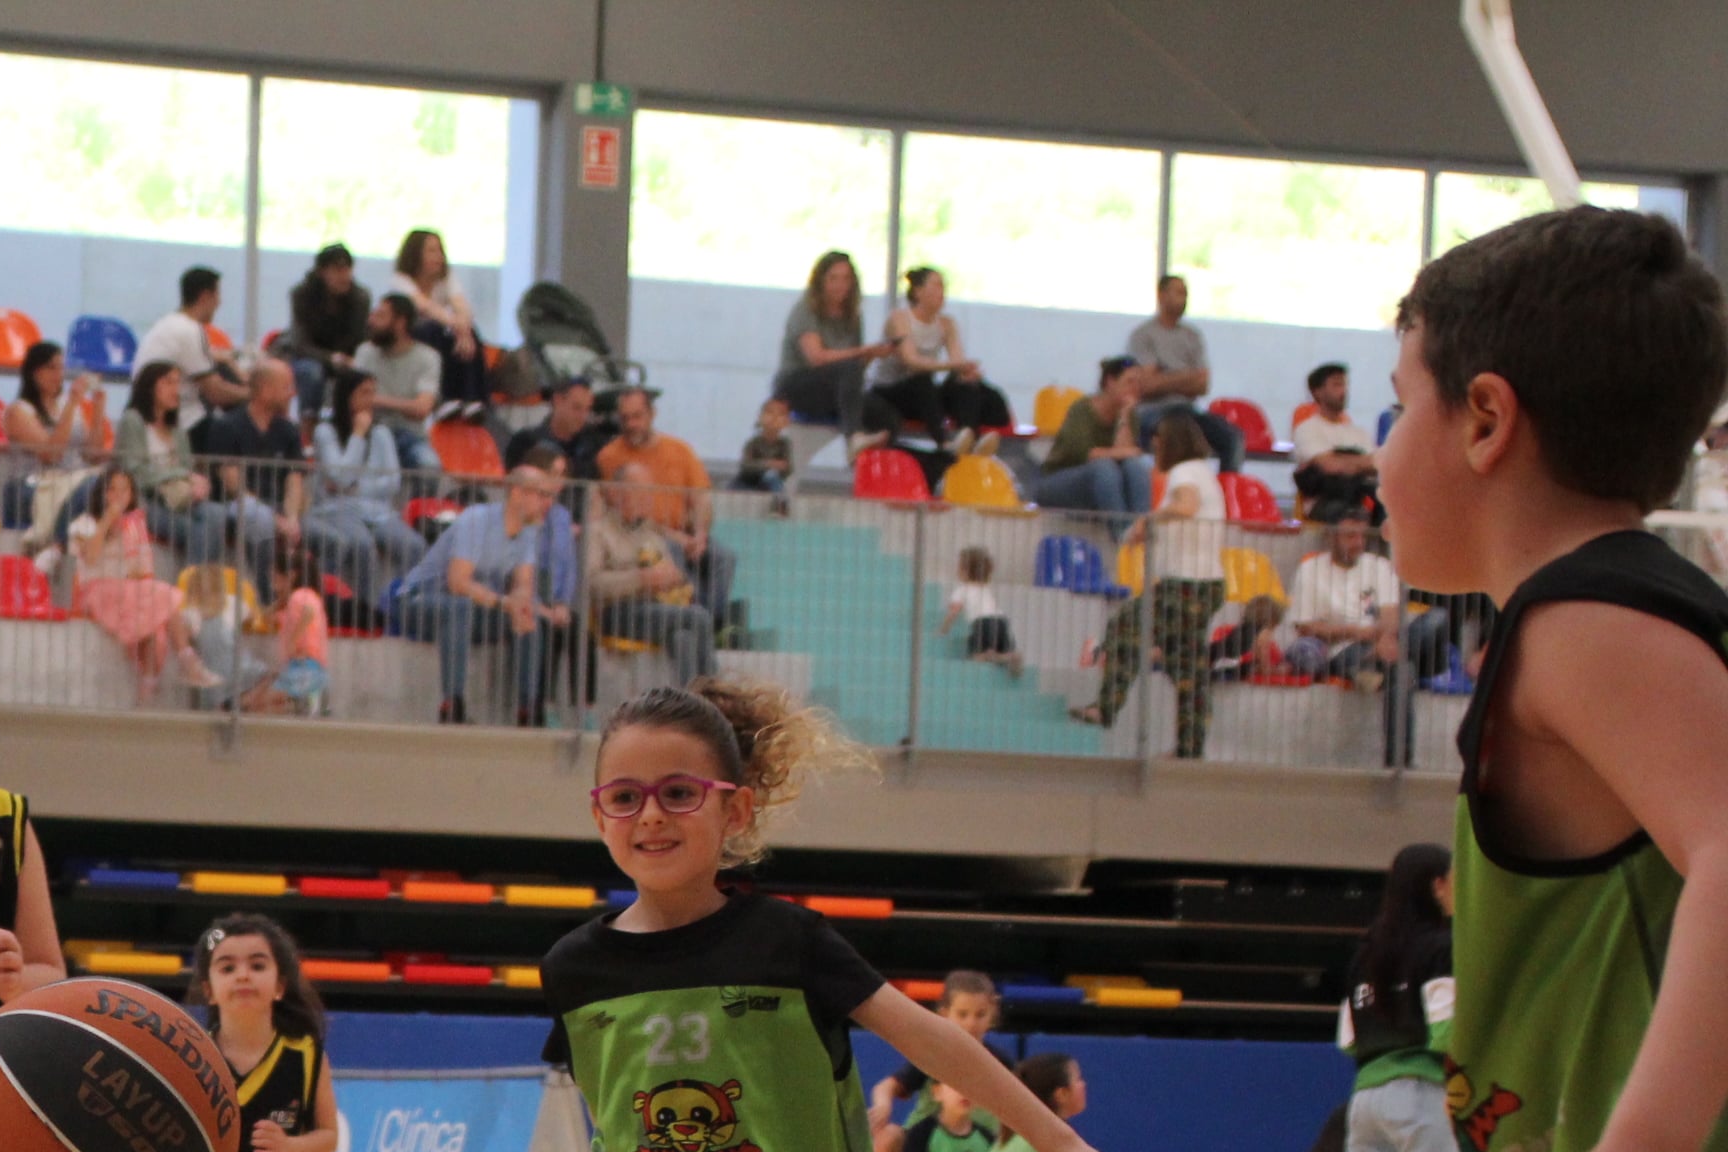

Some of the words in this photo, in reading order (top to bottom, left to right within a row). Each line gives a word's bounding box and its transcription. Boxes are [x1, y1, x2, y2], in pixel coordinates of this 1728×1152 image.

[85, 988, 236, 1139] SPALDING
[643, 1013, 711, 1066] 23
[82, 1049, 186, 1145] LAYUP
